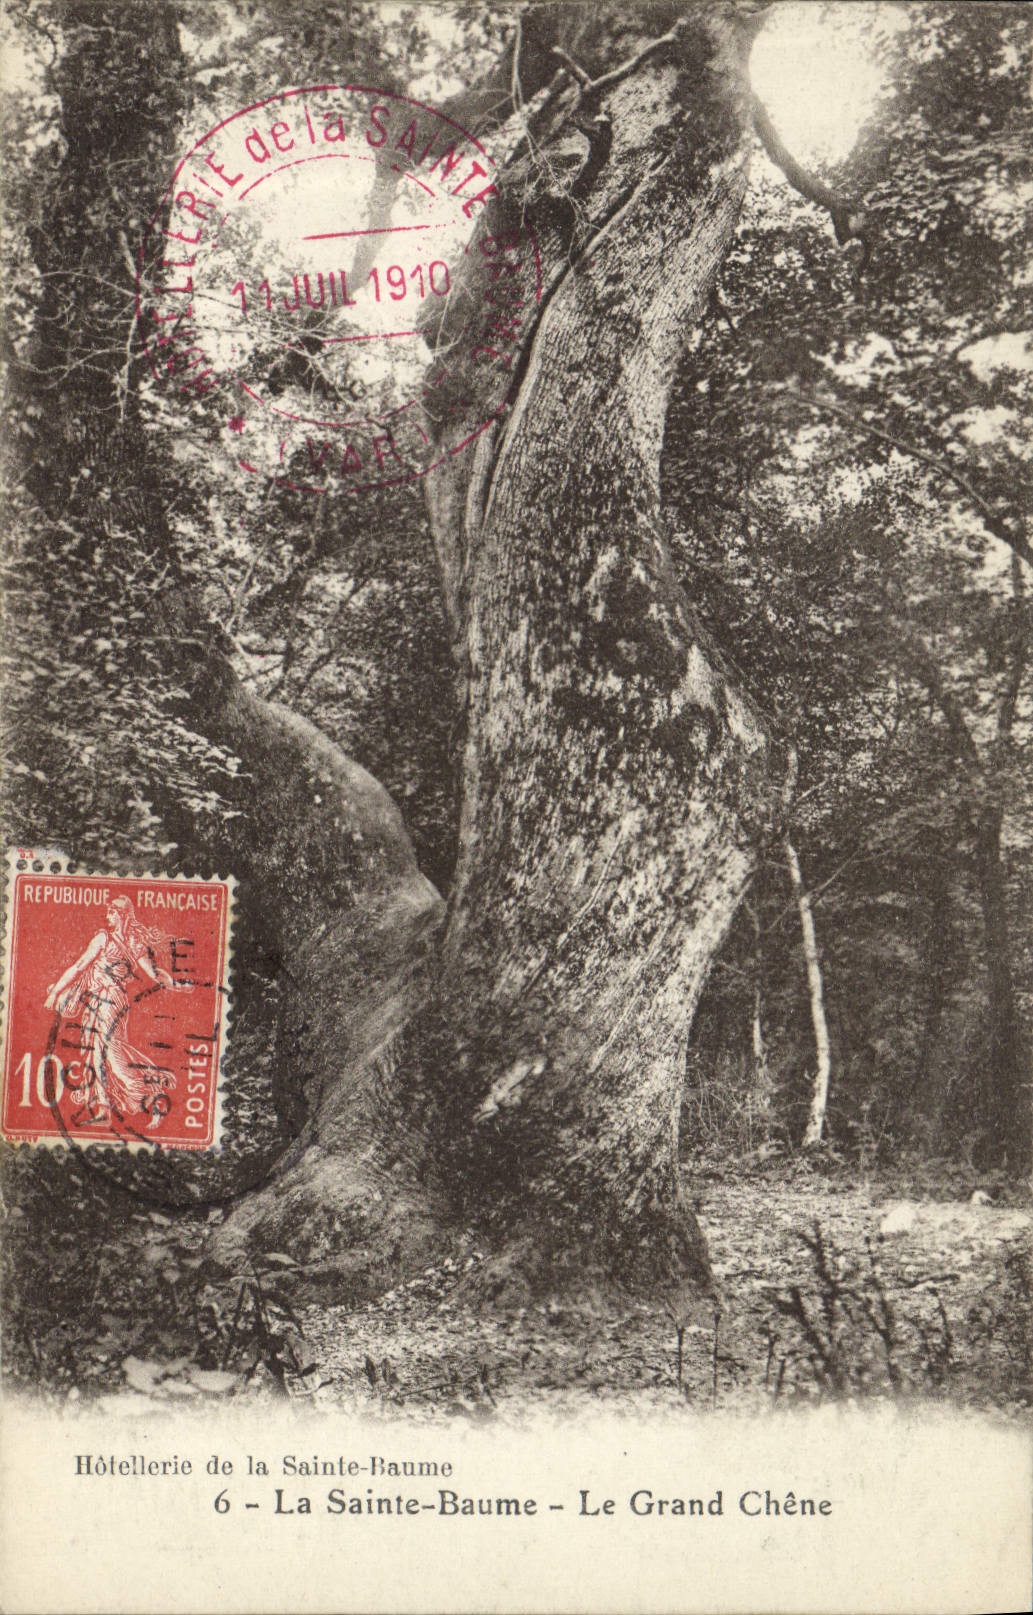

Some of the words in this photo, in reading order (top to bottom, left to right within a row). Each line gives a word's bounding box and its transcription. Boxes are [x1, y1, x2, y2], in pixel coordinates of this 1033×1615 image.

[243, 118, 296, 164] de
[303, 104, 347, 146] la
[364, 105, 501, 219] SAINTE
[230, 278, 274, 315] 11
[282, 269, 359, 313] JUIL
[365, 258, 452, 304] 1910
[23, 884, 111, 907] REPUBLIQUE
[136, 889, 219, 912] FRANÇAISE
[184, 1042, 210, 1129] POSTES
